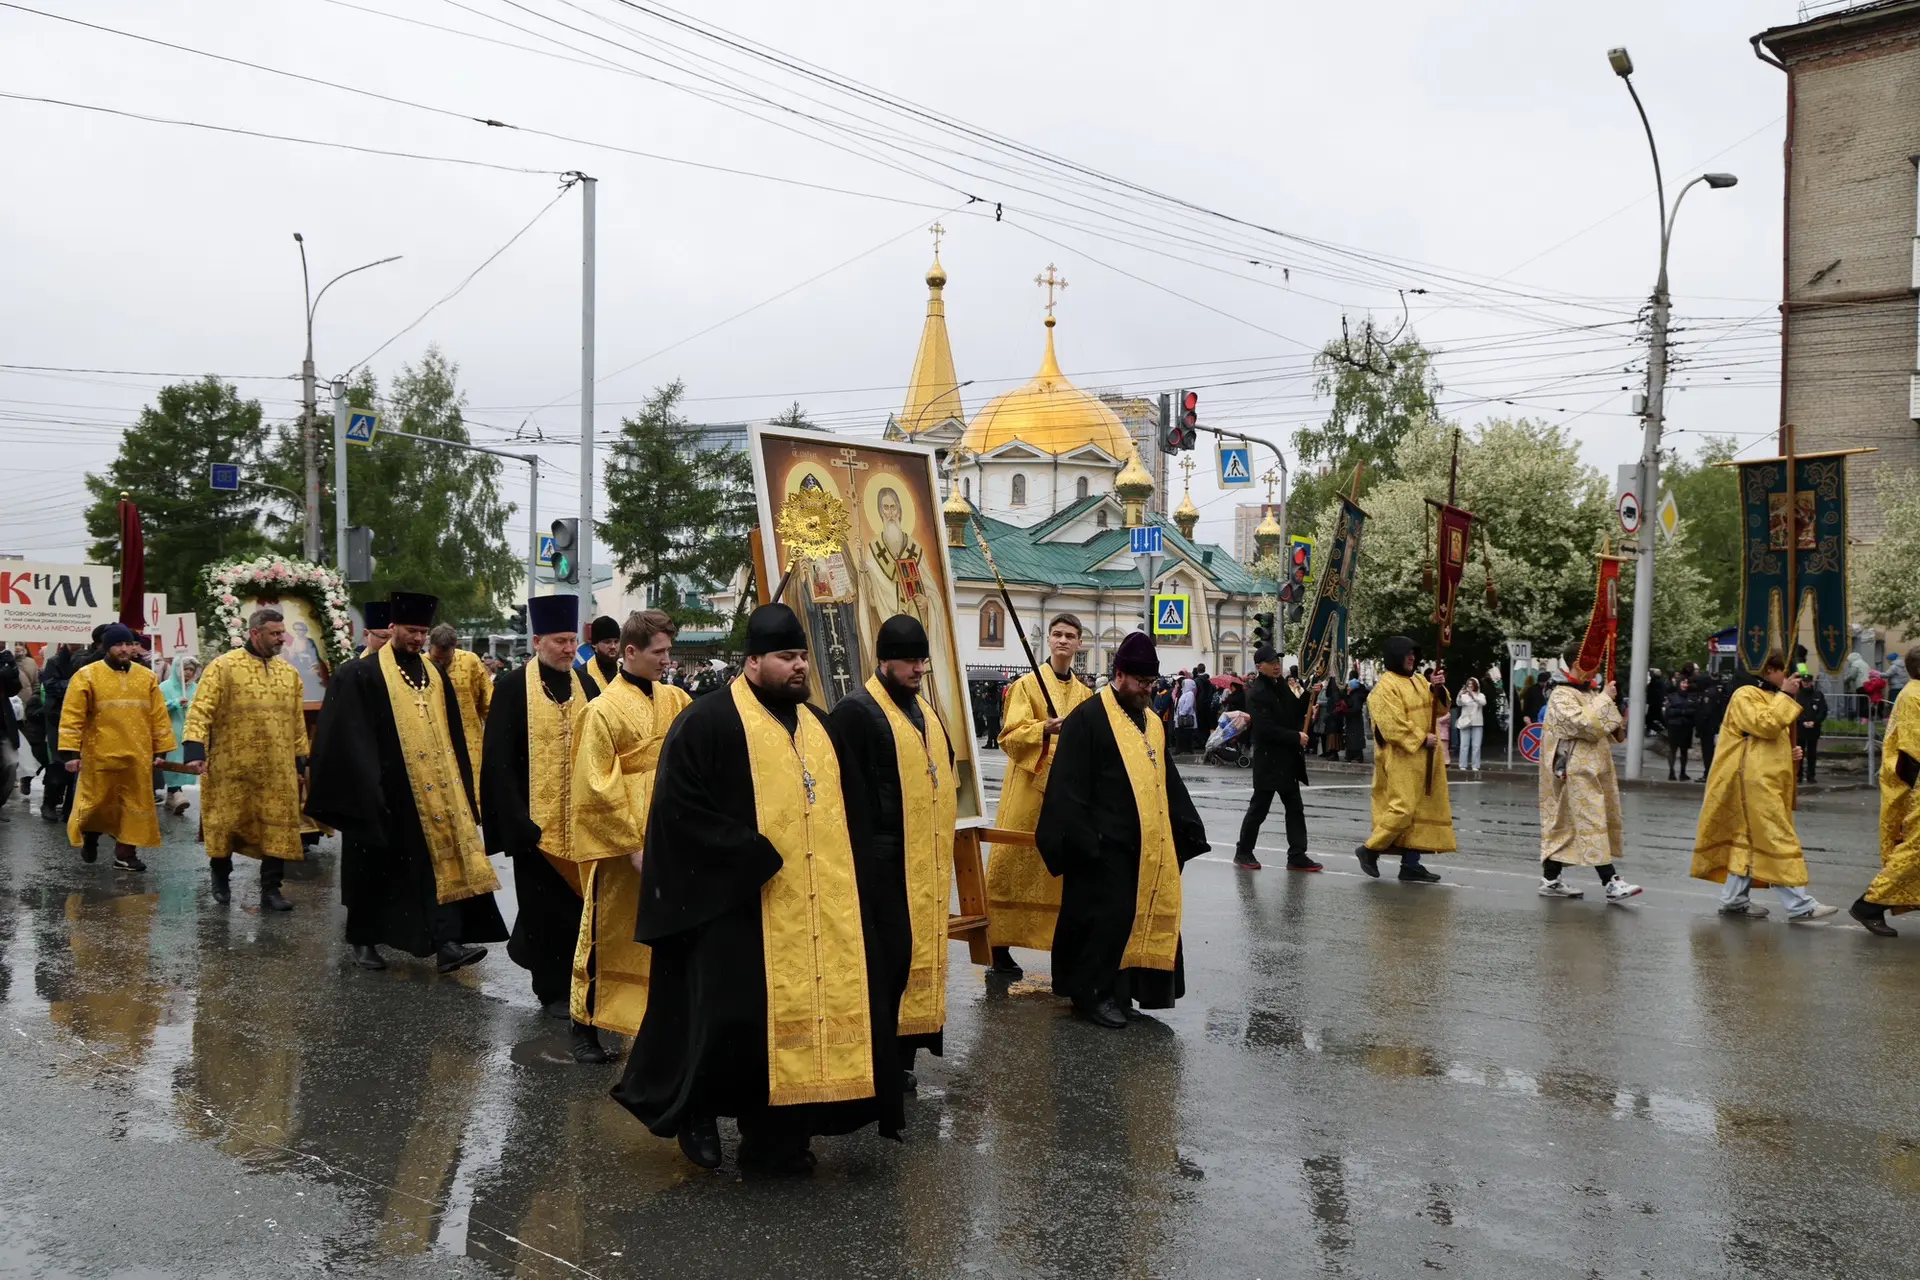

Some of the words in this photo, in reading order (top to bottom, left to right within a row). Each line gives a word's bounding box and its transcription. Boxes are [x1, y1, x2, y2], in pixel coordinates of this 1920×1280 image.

[4, 609, 57, 618] Православная
[4, 623, 42, 631] КИРИЛЛА
[51, 625, 91, 633] МЕФОДИЯ
